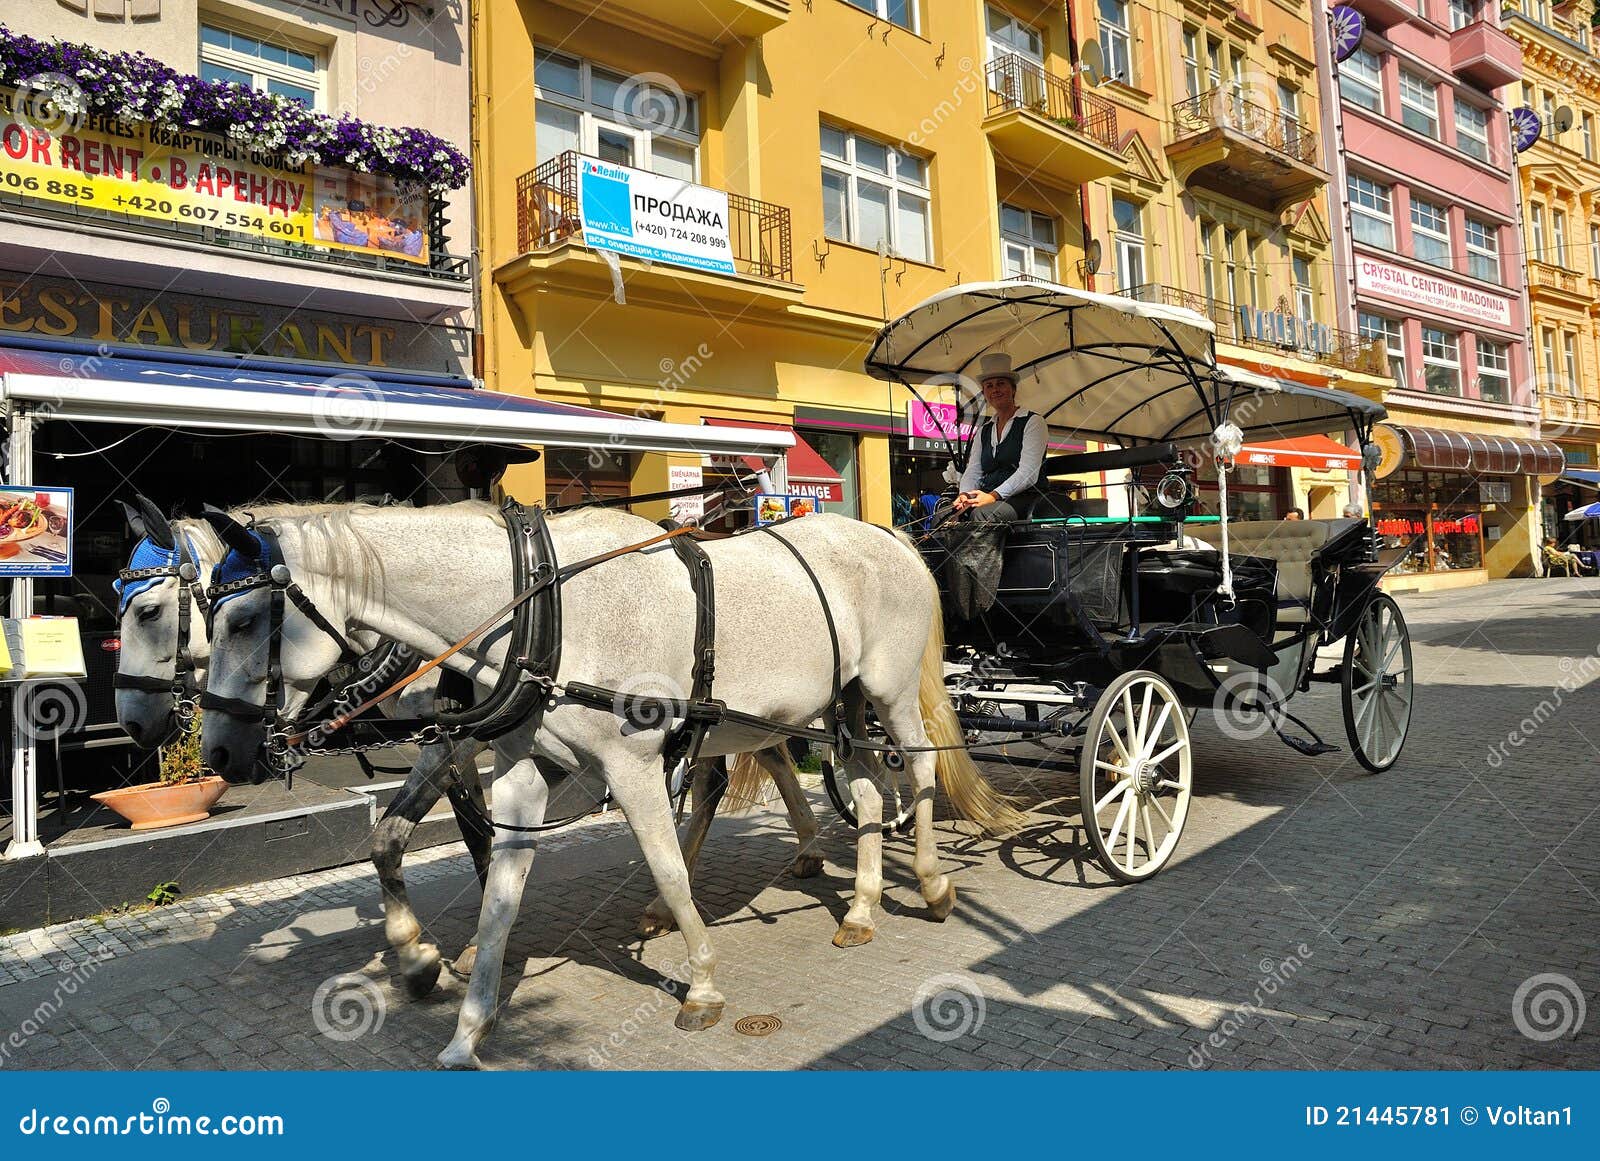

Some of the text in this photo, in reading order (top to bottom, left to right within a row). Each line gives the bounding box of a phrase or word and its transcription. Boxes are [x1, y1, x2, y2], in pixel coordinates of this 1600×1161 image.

[62, 134, 144, 183] RENT
[150, 127, 238, 161] КВАРТИРЫ
[47, 180, 95, 201] 885
[113, 195, 172, 213] +420
[178, 204, 219, 221] 607
[225, 212, 264, 230] 554
[269, 221, 304, 238] 601
[195, 163, 305, 218] АРЕНДУ
[634, 194, 723, 229] ПРОДАЖА
[587, 219, 631, 235] www.7k.cz
[635, 221, 726, 249] (+420) 724 208 999
[1363, 262, 1506, 313] CRYSTAL CENTRUM MADONNA
